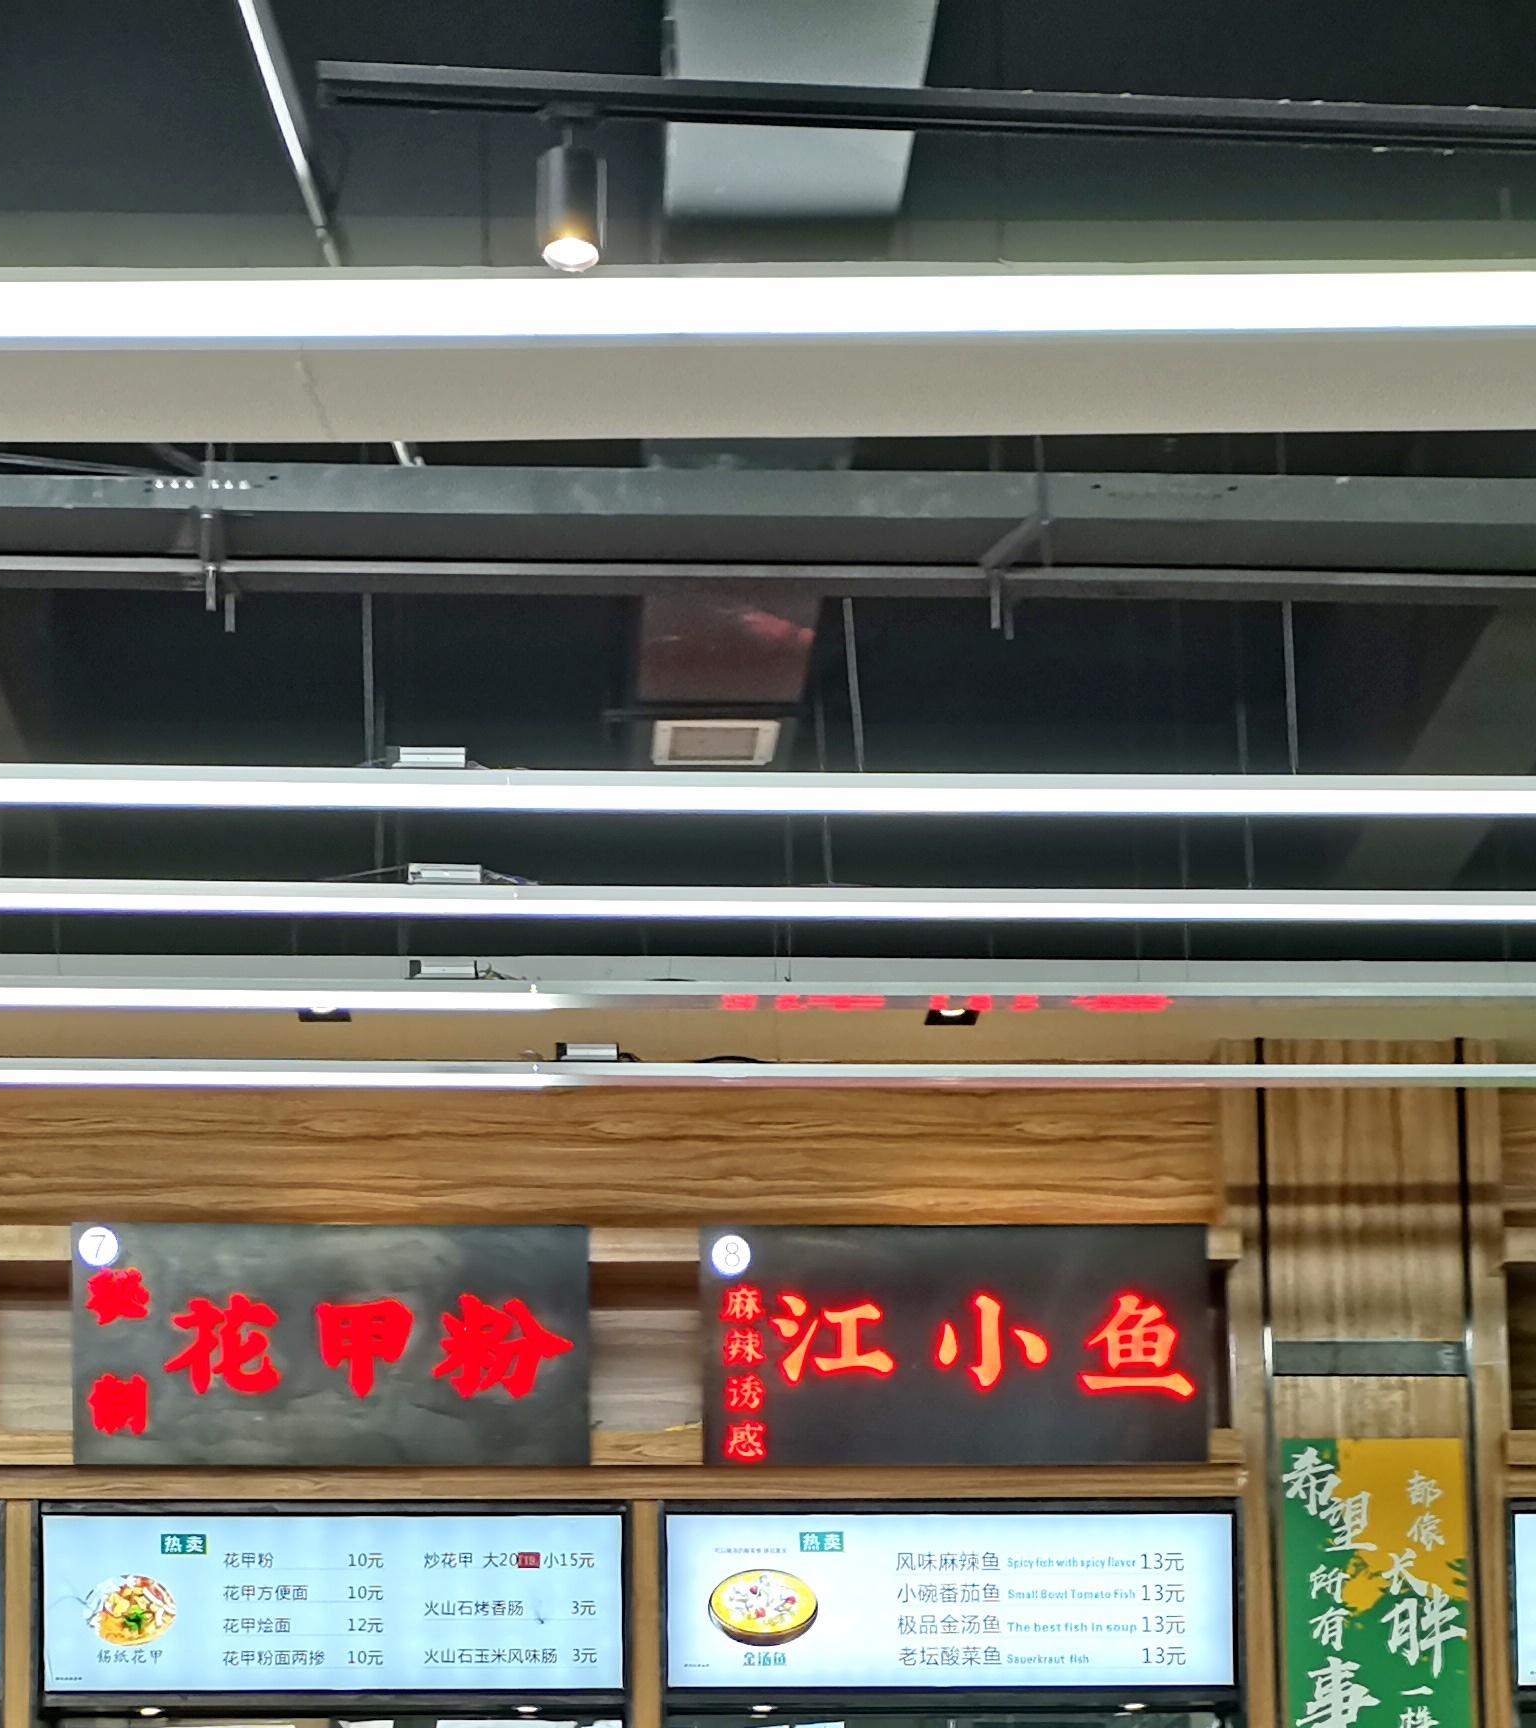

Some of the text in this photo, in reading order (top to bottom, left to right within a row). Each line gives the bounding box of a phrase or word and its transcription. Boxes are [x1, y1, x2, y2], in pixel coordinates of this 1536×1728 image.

[89, 1234, 107, 1259] 7
[724, 1241, 741, 1267] 8
[164, 1293, 574, 1399] 花甲粉
[769, 1292, 1196, 1399] 江小鱼
[721, 1285, 766, 1461] 麻辣诱惑
[163, 1535, 205, 1553] 热卖
[802, 1532, 842, 1551] 热卖
[222, 1552, 384, 1569] 花甲粉 10元
[423, 1552, 474, 1569] 炒花甲
[542, 1552, 595, 1569] 小15元
[896, 1551, 1001, 1572] 风味麻辣鱼
[1140, 1552, 1185, 1572] 13元
[222, 1584, 384, 1602] 花甲方便面 10元
[896, 1583, 1001, 1604] 小碗番茄鱼
[1007, 1588, 1038, 1600] Small
[1040, 1588, 1068, 1600] Bowl
[1070, 1588, 1111, 1600] Tomato
[1140, 1583, 1186, 1604] 13元
[423, 1600, 597, 1617] 火山石烤香肠 3元
[222, 1617, 384, 1634] 花甲烩面 12元
[896, 1614, 1002, 1635] 极品金汤鱼
[1007, 1621, 1031, 1633] The
[1033, 1621, 1062, 1633] best
[1064, 1621, 1088, 1633] fish
[1105, 1623, 1138, 1635] soup
[1141, 1615, 1186, 1635] 13元
[222, 1650, 384, 1667] 花甲粉面两掺 10元
[423, 1647, 598, 1665] 火山石玉米风味肠 3元
[897, 1645, 1002, 1667] 老坛酸菜鱼
[1068, 1653, 1090, 1665] fish
[1141, 1646, 1186, 1667] 13元
